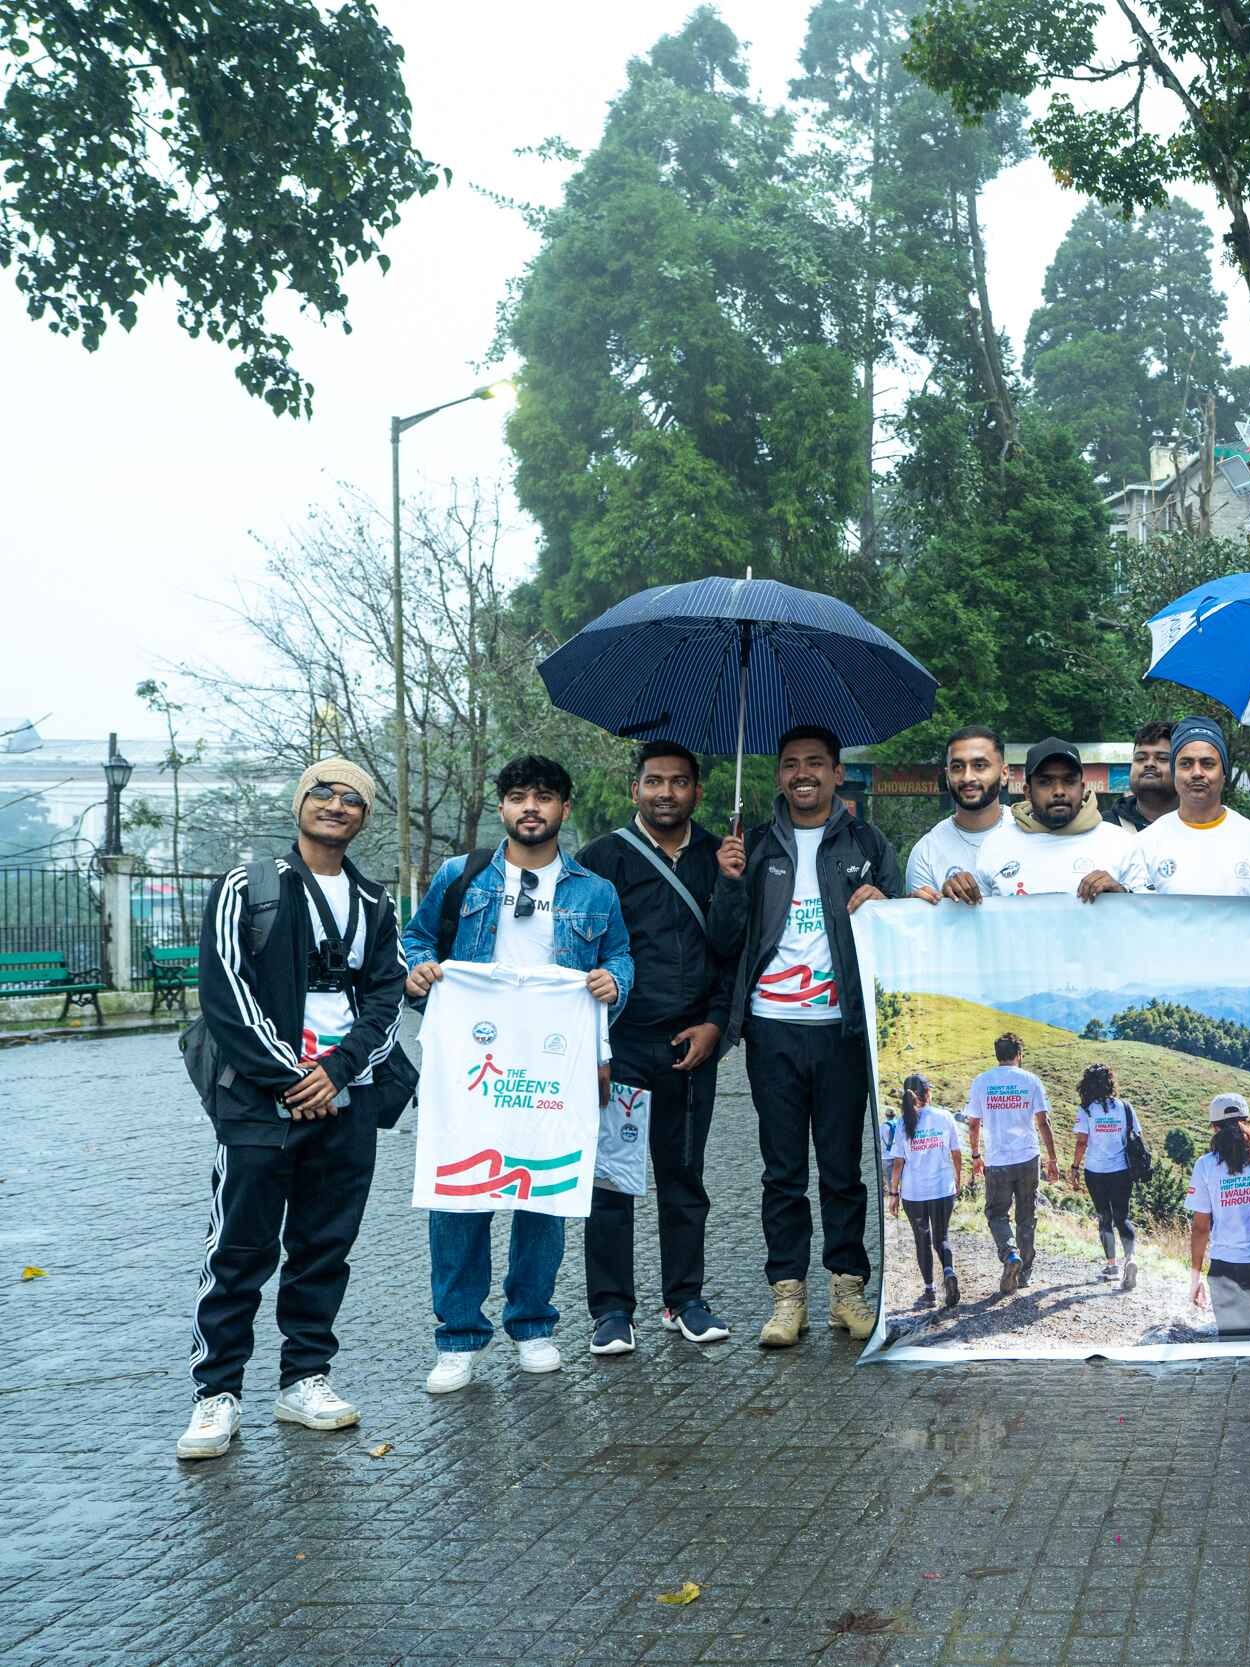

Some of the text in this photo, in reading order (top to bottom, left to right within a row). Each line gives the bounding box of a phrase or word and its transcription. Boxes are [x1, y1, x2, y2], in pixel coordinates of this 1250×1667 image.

[877, 781, 940, 793] CHOWRASTA
[796, 921, 823, 934] TRA
[507, 1069, 527, 1078] THE
[493, 1079, 560, 1094] QUEEN'S
[493, 1095, 564, 1110] TRAIL 2026
